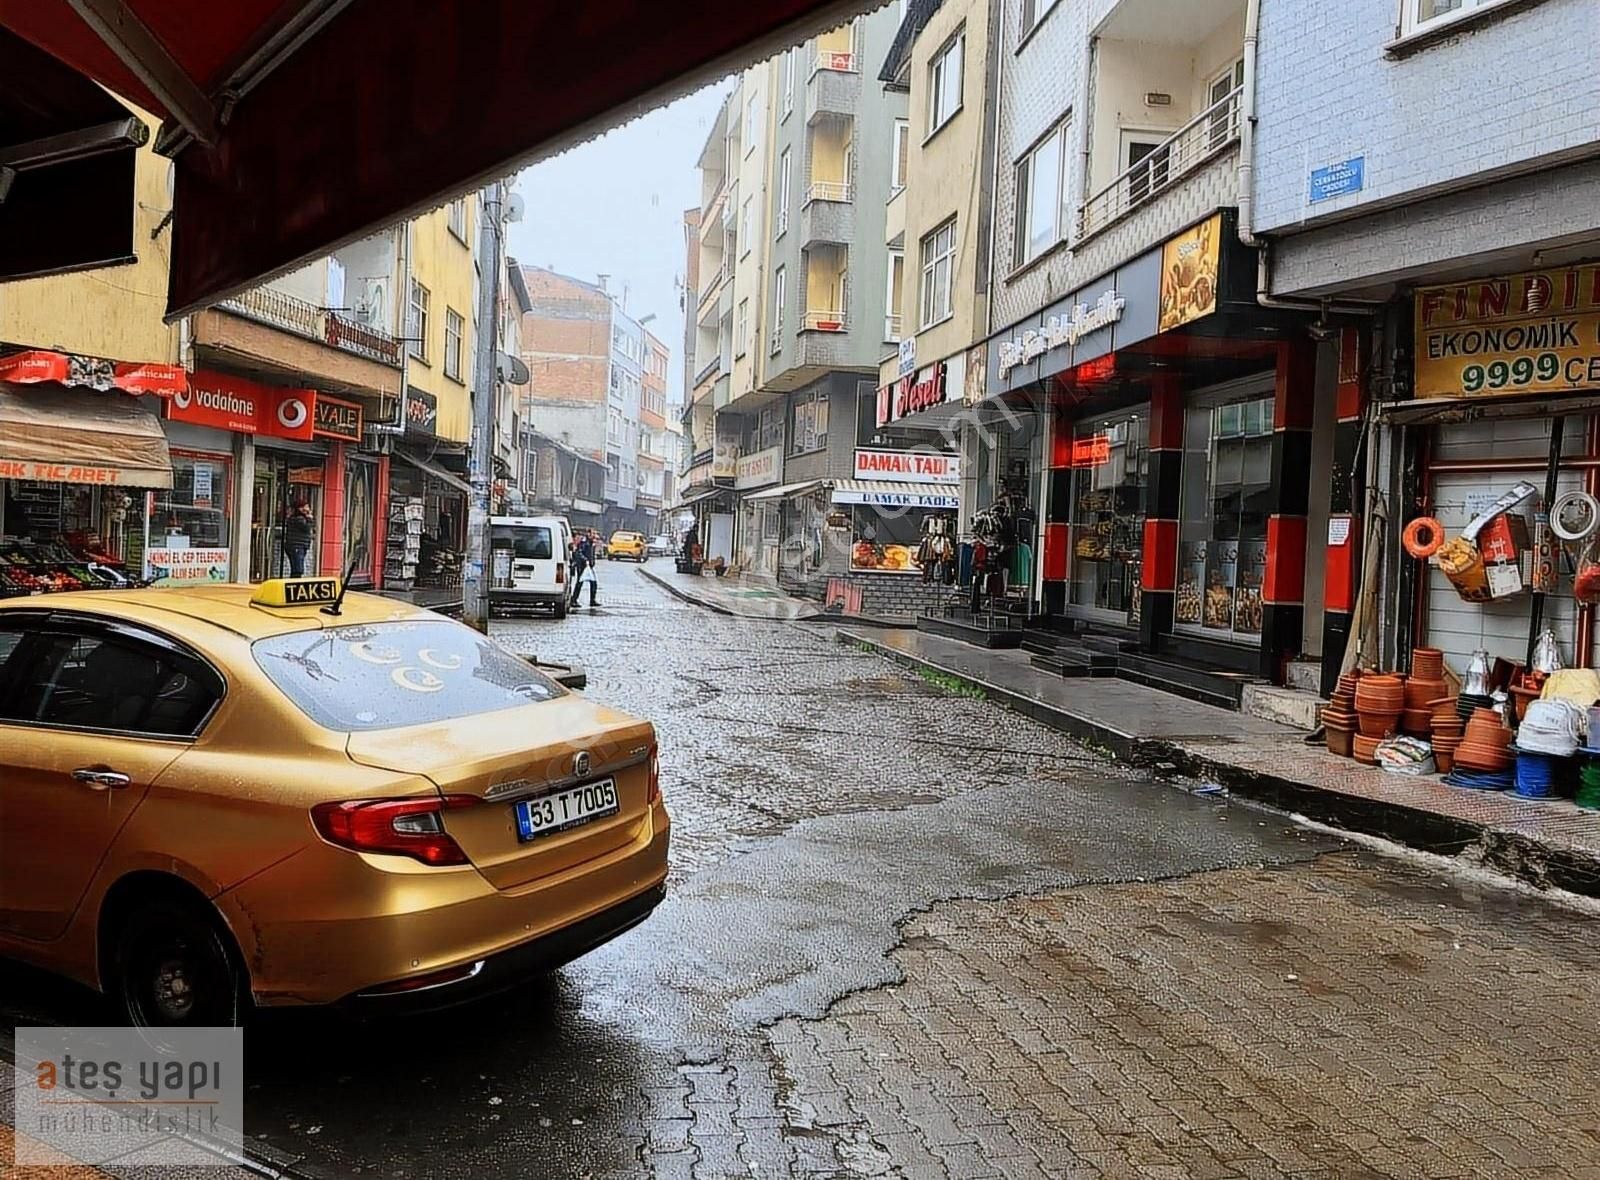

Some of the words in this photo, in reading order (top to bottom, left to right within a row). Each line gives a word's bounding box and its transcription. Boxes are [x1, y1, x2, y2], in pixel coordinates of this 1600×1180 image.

[1428, 316, 1580, 359] EKONOMİK
[1461, 350, 1560, 392] 9999
[195, 388, 254, 416] vodafone
[857, 453, 913, 473] DAMAK
[914, 457, 948, 475] TADI
[862, 493, 911, 505] DAMAK
[287, 583, 335, 602] TAKSİ
[531, 799, 556, 829] 53
[559, 794, 570, 820] T
[574, 781, 615, 815] 7005
